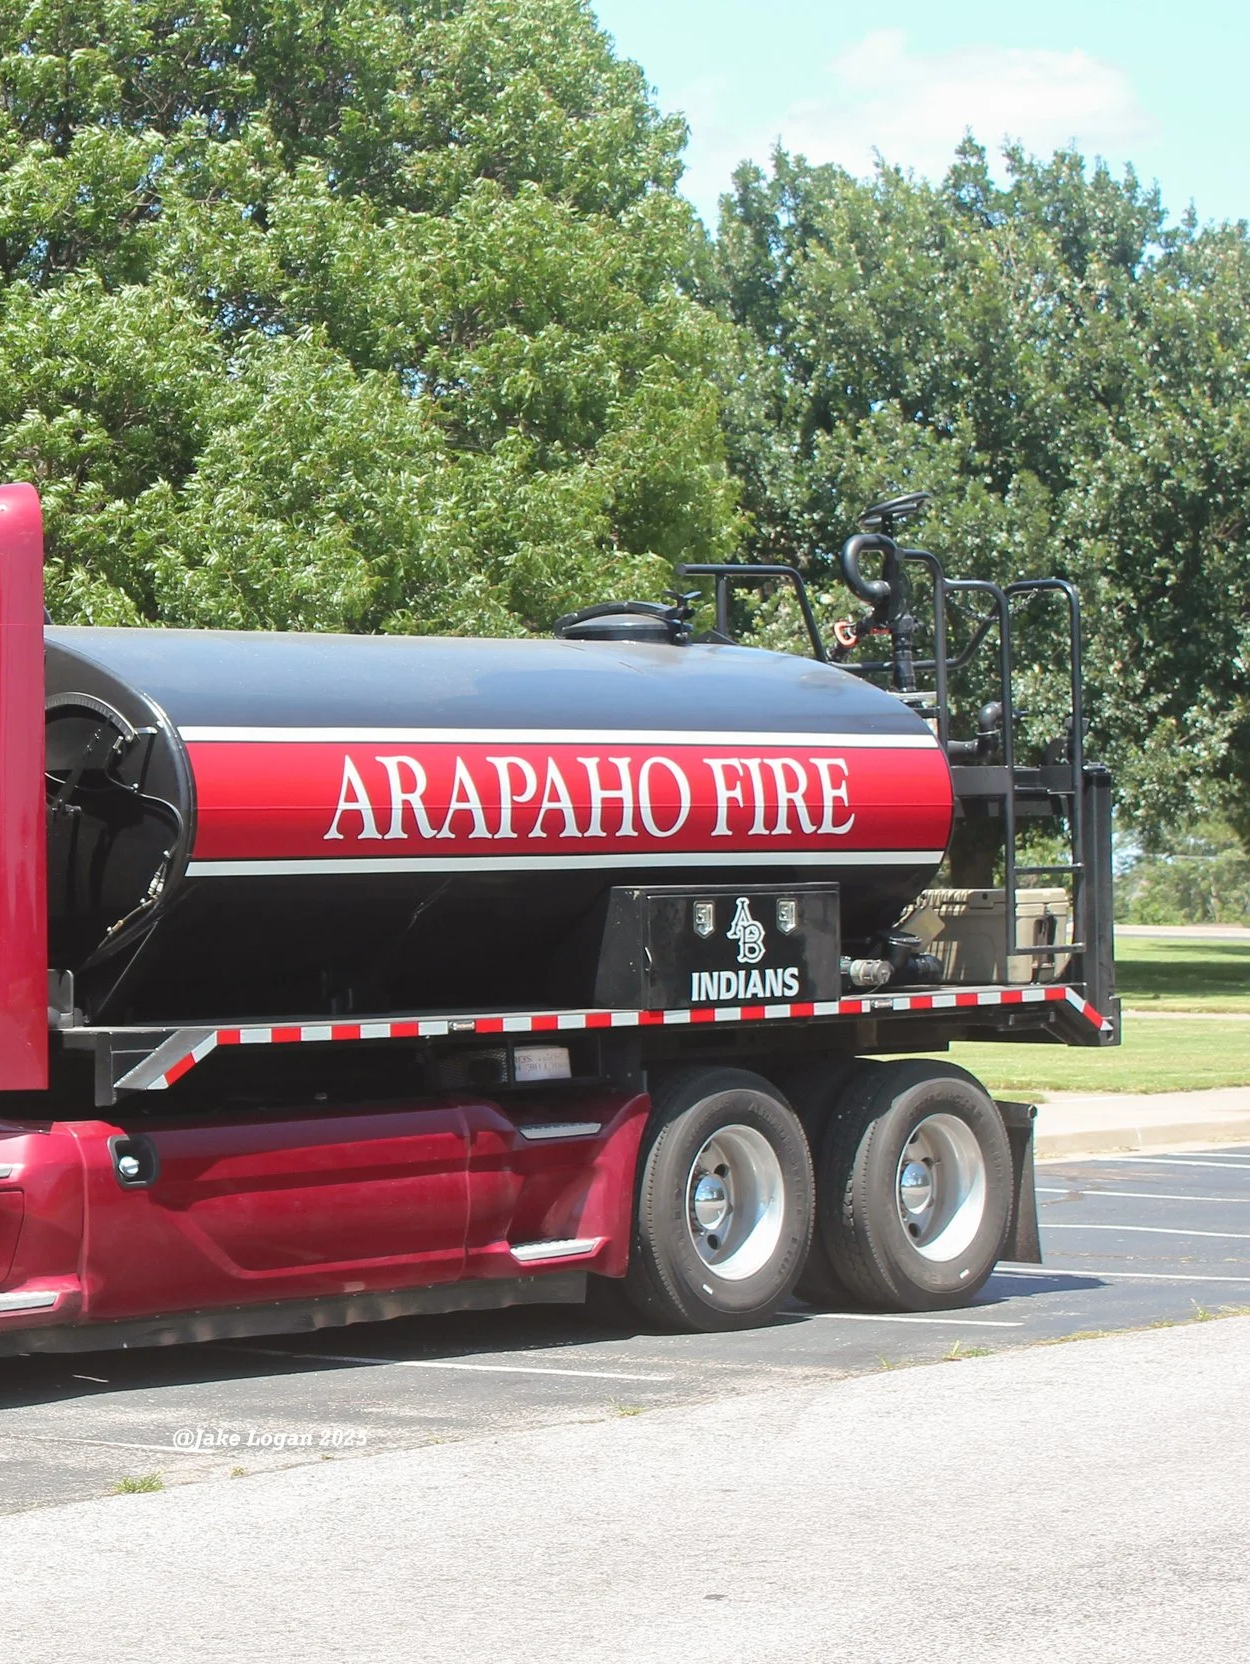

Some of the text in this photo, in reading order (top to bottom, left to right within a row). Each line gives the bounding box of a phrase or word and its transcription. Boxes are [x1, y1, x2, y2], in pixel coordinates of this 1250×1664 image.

[323, 754, 856, 840] ARAPAHO FIRE
[691, 967, 800, 1002] INDIANS
